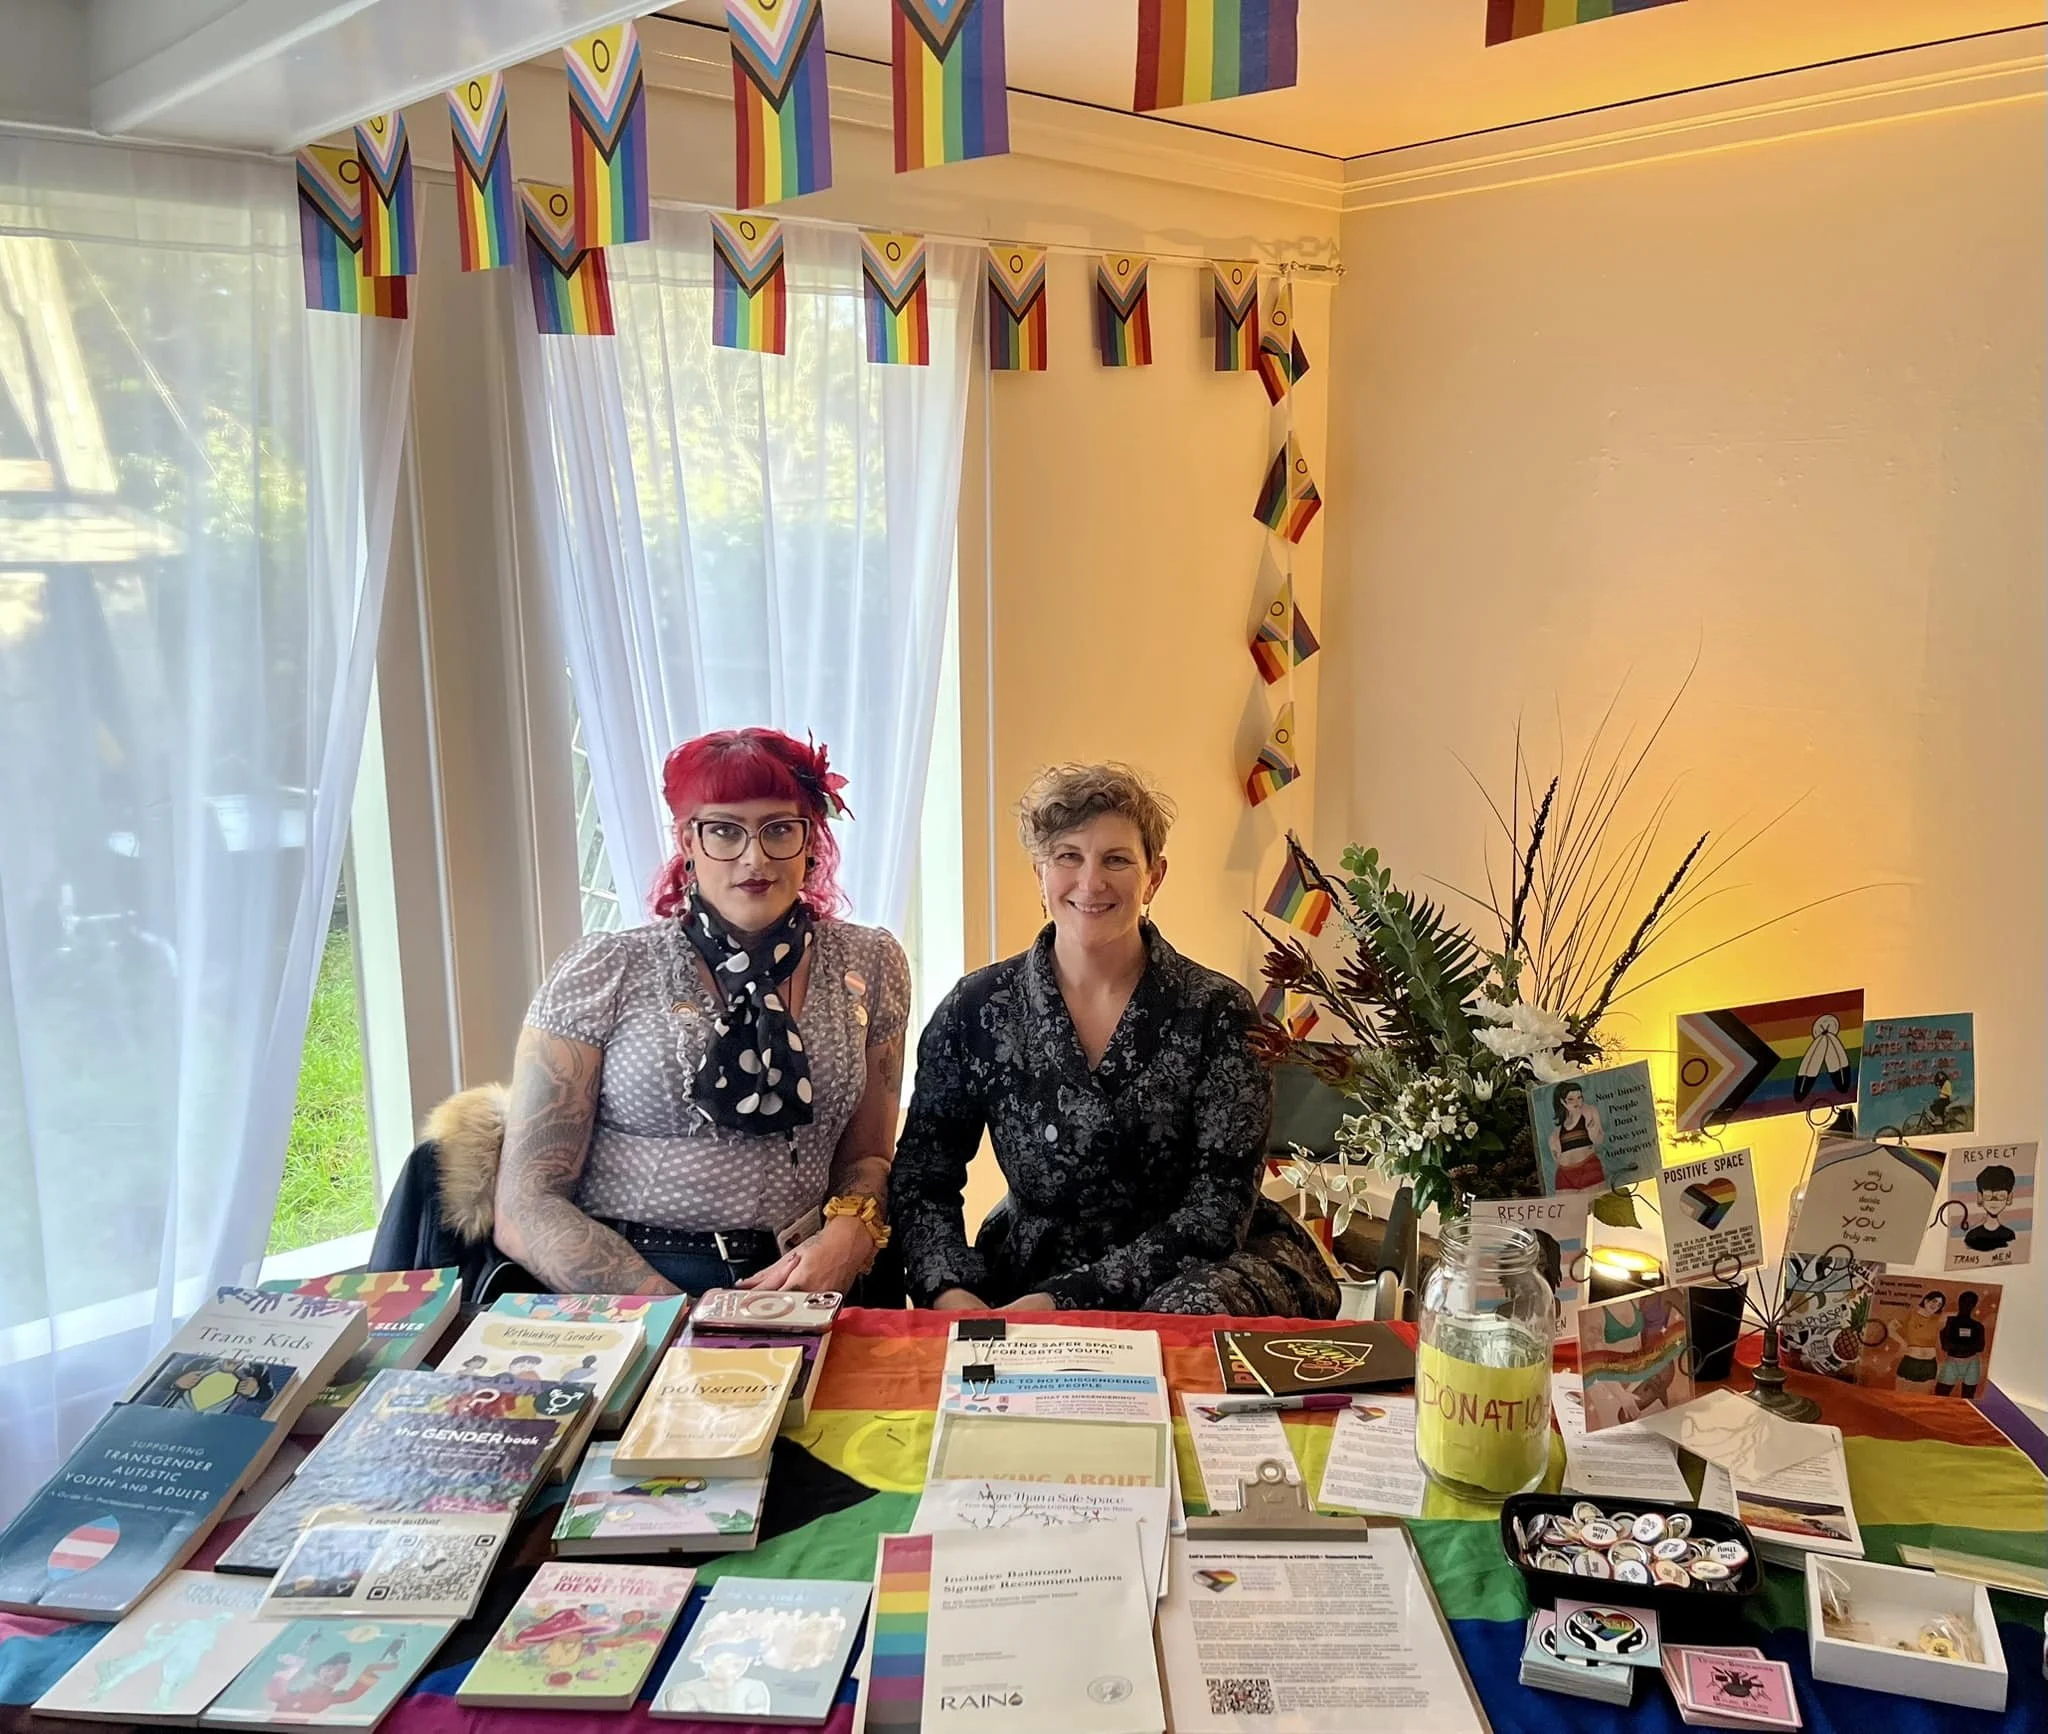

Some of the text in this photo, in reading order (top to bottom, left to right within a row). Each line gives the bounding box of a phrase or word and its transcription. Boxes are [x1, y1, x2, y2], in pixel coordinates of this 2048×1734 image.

[1963, 1147, 2018, 1164] RESPECT
[1663, 1153, 1744, 1184] POSITIVE SPACE
[1852, 1180, 1893, 1192] YOU
[1497, 1204, 1566, 1221] RESPECT
[1842, 1215, 1885, 1229] YOU
[1953, 1251, 2012, 1264] TRANS MEN
[374, 1322, 425, 1330] SELVES
[503, 1326, 606, 1343] Rethinking Gender
[198, 1326, 314, 1351] Trans Kids
[1085, 1342, 1134, 1350] SPACES
[660, 1383, 782, 1396] polysecure
[1422, 1372, 1549, 1432] DONATIO
[395, 1427, 540, 1446] the GENDER book
[130, 1439, 205, 1456] SUPPORTING
[104, 1449, 213, 1472] TRANSGENDER
[112, 1465, 182, 1482] AUTISTIC
[64, 1471, 210, 1501] YOUTH AND ADULTS
[1058, 1494, 1084, 1503] Safe
[1087, 1495, 1125, 1505] Space
[402, 1518, 441, 1526] author
[560, 1575, 603, 1583] QUEER
[1008, 1568, 1072, 1578] Bathroom
[944, 1575, 1123, 1594] Signage Recommendations
